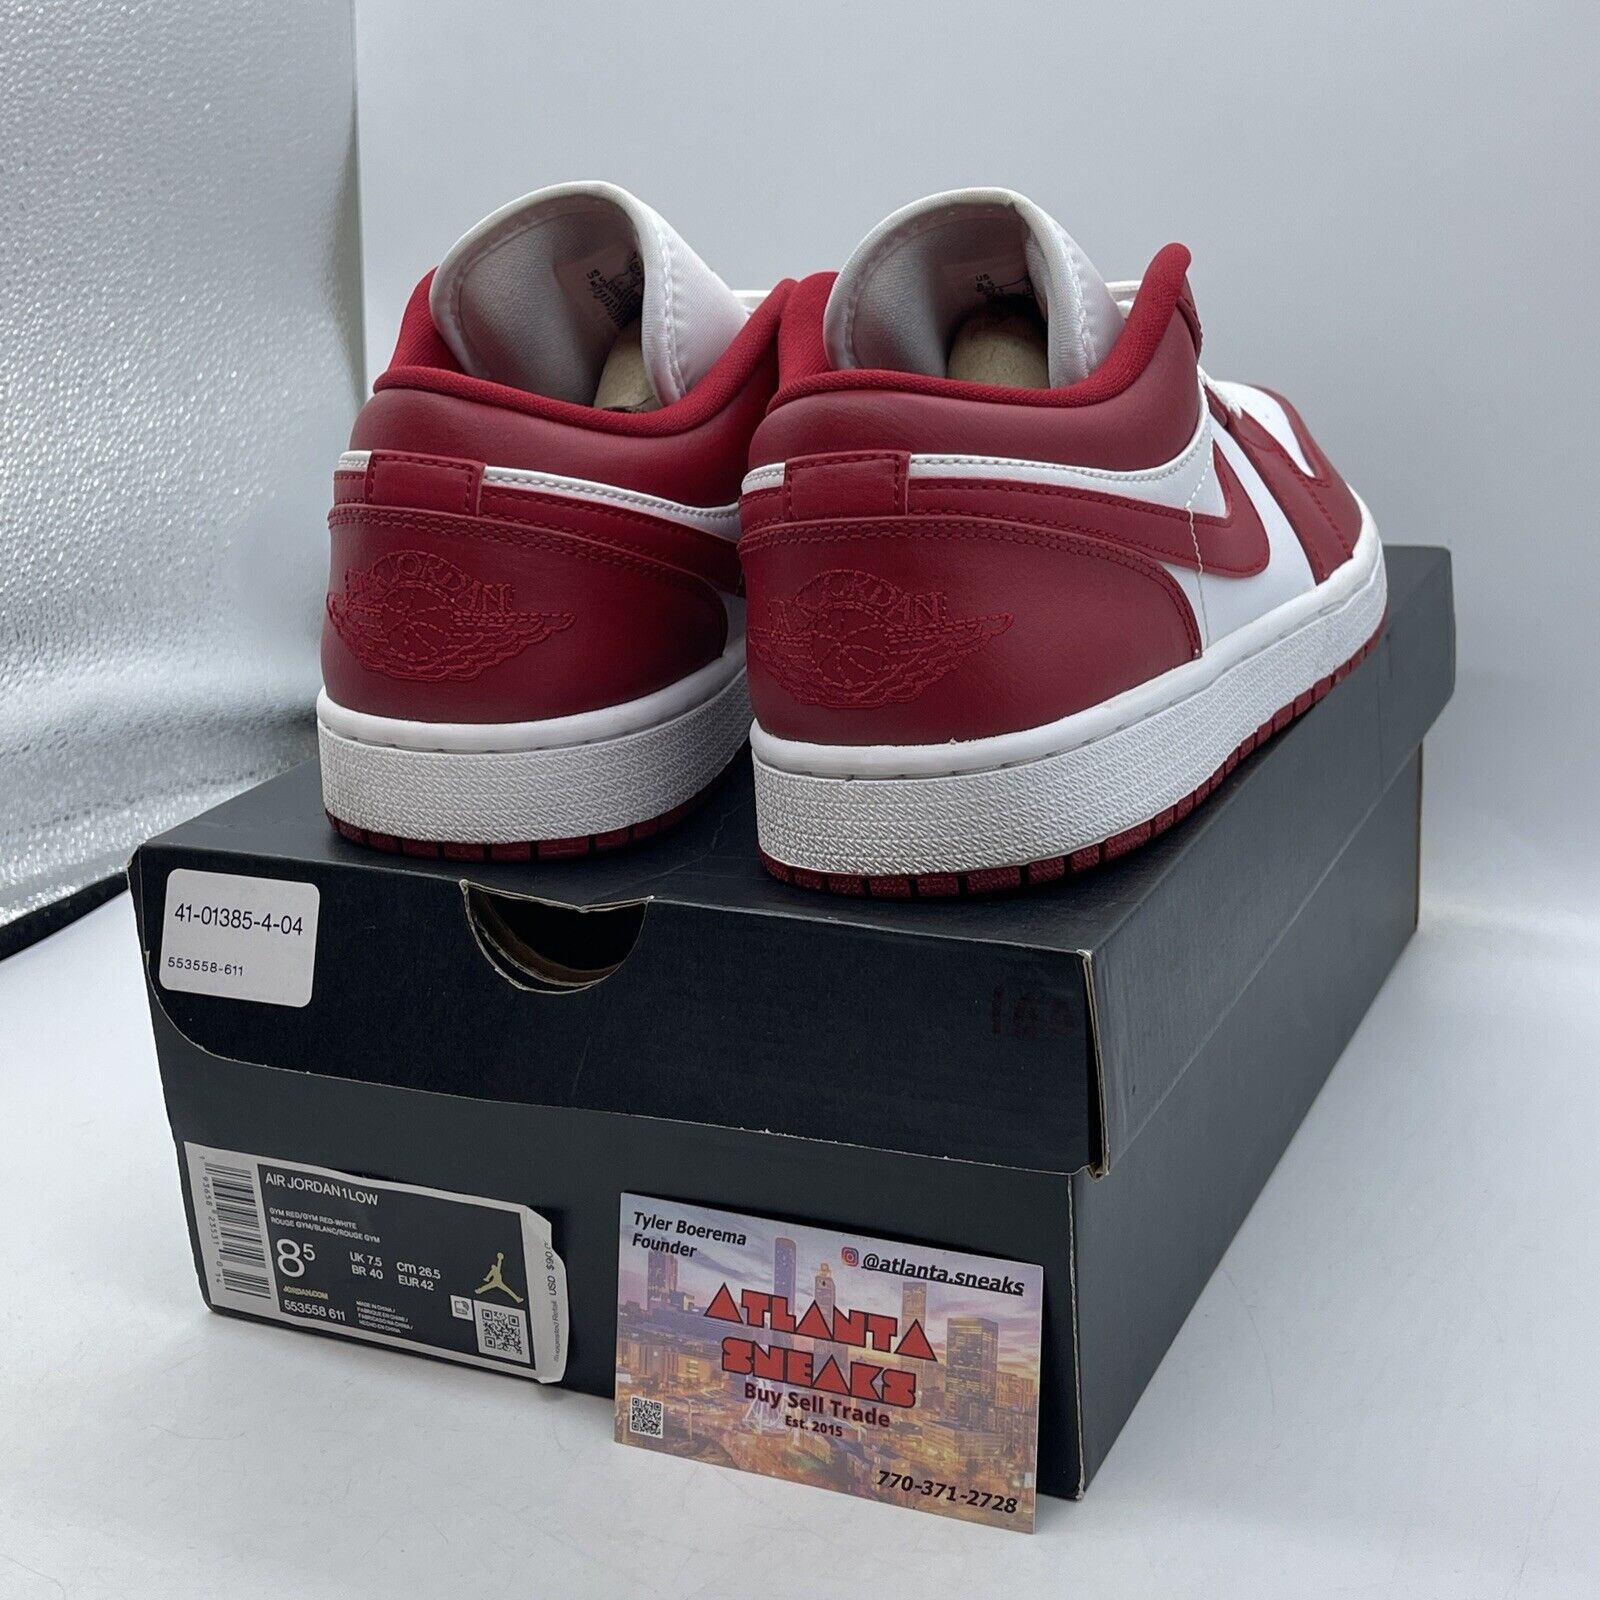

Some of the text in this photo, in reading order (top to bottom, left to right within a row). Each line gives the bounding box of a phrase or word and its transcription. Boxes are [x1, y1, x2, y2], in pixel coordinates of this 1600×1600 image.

[174, 902, 304, 937] 41-01385-4-04
[167, 955, 245, 977] 553558-611
[265, 1172, 286, 1188] AIR
[287, 1178, 341, 1198] JORDAN
[348, 1188, 379, 1206] LOW
[269, 1207, 358, 1230] GYM RED/GYM RED-WHITE
[270, 1216, 295, 1228] ROUGE
[363, 1234, 381, 1244] GYM
[634, 1211, 747, 1246] Tyler Boerema
[632, 1232, 698, 1258] Founder
[349, 1251, 366, 1264] UK
[366, 1254, 383, 1268] 7.5
[418, 1265, 442, 1280] 26.5
[351, 1264, 435, 1292] BR 40 EUR 42
[861, 1252, 1025, 1297] @atlanta.sneaks
[283, 1285, 330, 1300] JORDAN.COM
[547, 1275, 557, 1296] USD
[284, 1299, 346, 1321] 553558 611
[703, 1282, 938, 1362] ATLANTA
[721, 1336, 917, 1409] SNEAKS
[744, 1382, 891, 1428] Buy Sell Trade
[785, 1415, 843, 1437] Est. 2015
[876, 1469, 1018, 1515] 770-371-2728
